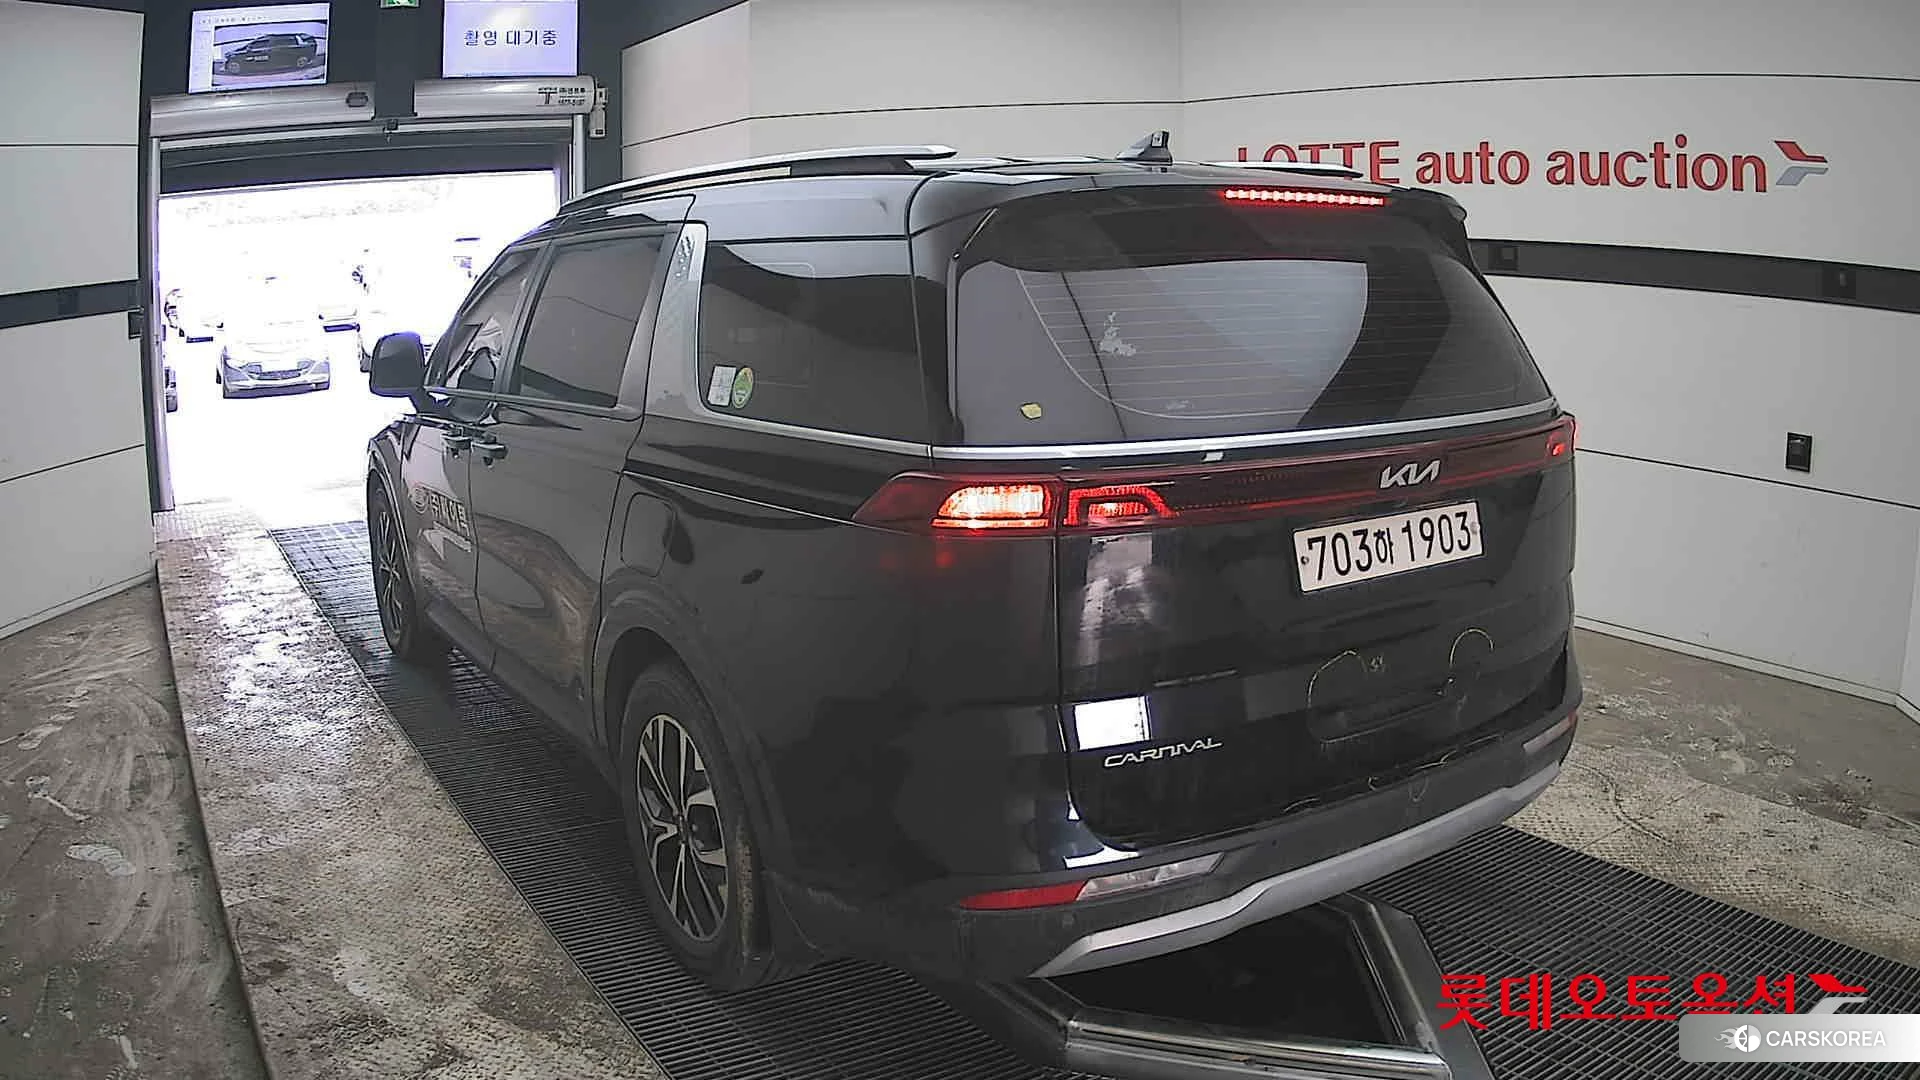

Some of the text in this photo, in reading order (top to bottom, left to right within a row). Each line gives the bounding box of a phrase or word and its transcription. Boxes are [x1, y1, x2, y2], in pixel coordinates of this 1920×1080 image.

[464, 29, 557, 46] 촬영 대기중
[1415, 141, 1530, 186] auto
[1546, 134, 1768, 194] auction
[1379, 460, 1441, 489] KIA
[1307, 511, 1471, 581] 703하 1903
[1103, 737, 1223, 768] CARNIVAL
